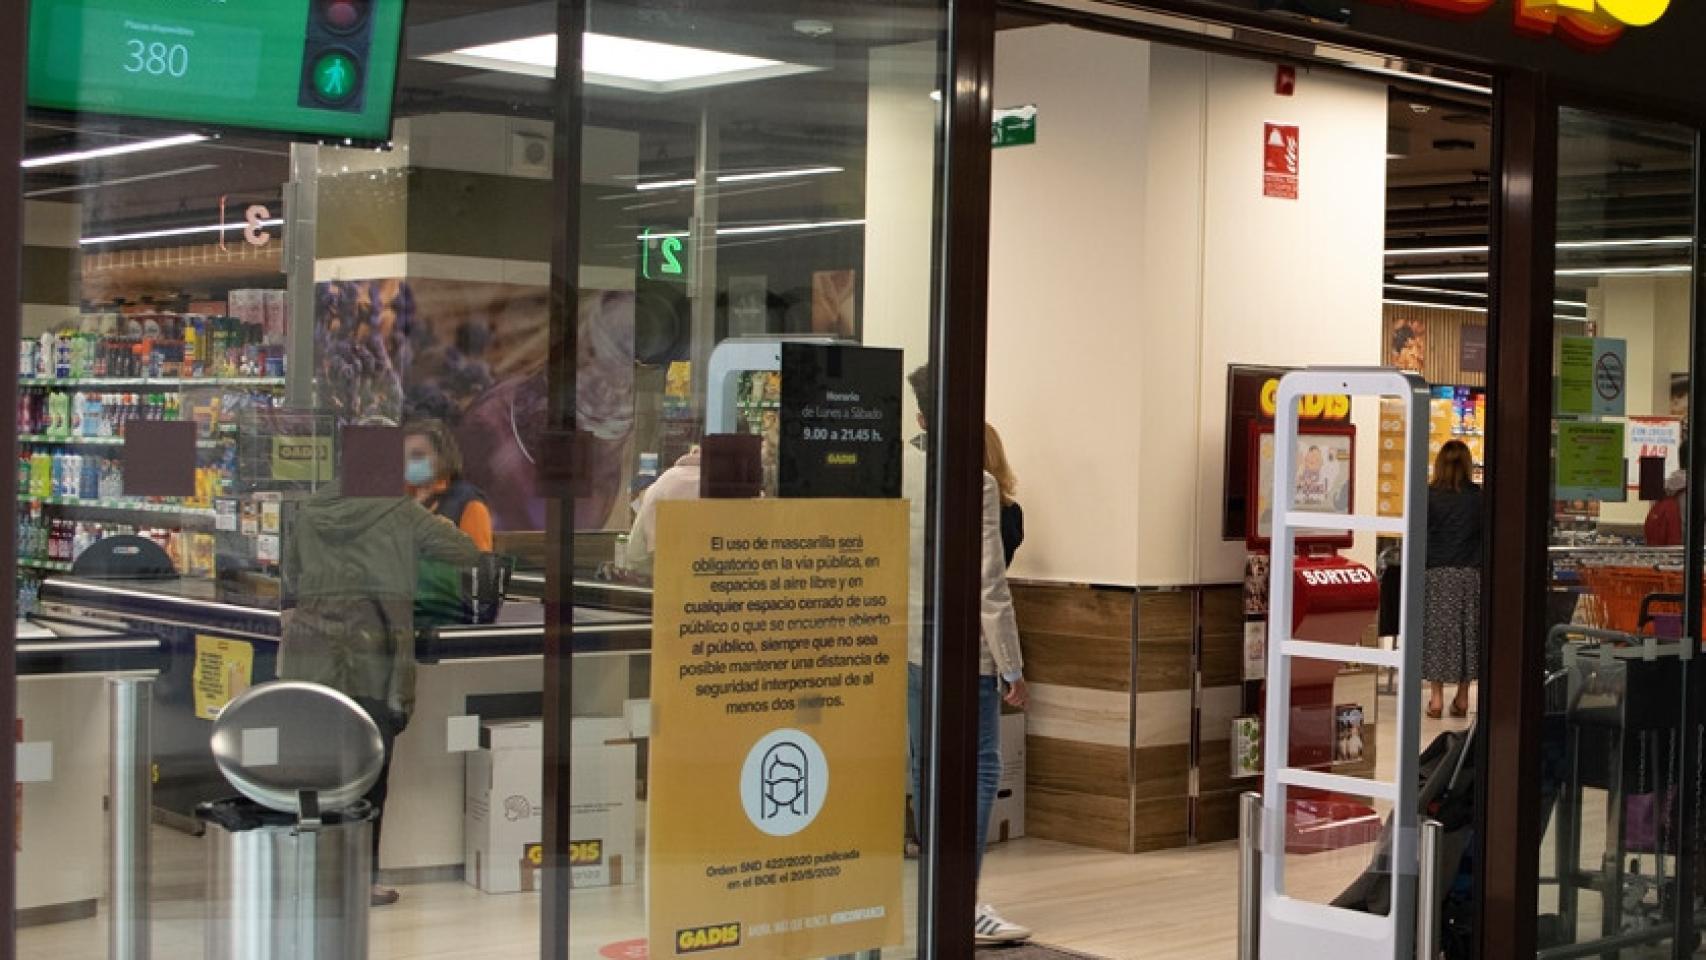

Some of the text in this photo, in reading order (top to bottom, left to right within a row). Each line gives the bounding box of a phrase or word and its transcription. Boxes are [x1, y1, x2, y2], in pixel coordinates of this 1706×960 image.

[123, 39, 188, 77] 380
[826, 391, 859, 401] Horario
[1261, 378, 1349, 418] GDIS
[802, 406, 815, 418] de
[816, 407, 840, 418] Lunes
[803, 427, 828, 440] 9.00
[831, 431, 838, 440] a
[872, 429, 882, 441] h.
[711, 535, 863, 550] El uso de mascarilla será
[692, 555, 880, 573] obligatorio en la vía pública, en
[710, 576, 863, 592] espacios al aire libre y en
[1303, 568, 1372, 586] SORTEO
[684, 595, 886, 614] cualquier espacio cerrado de uso
[680, 614, 890, 638] público o que se encuentre abierto
[692, 635, 878, 656] al público, siempre que no sea
[680, 652, 889, 678] posible mantener una distancia de
[696, 672, 874, 698] seguridad interpersonal de al
[726, 701, 768, 714] menos
[772, 697, 795, 711] dos
[528, 842, 600, 866] GDIS
[706, 849, 860, 877] Orden SND 422/2020 publicada
[727, 880, 742, 890] en
[743, 876, 752, 887] el
[755, 873, 777, 887] BOE
[780, 871, 789, 883] el
[679, 925, 738, 949] GADIS
